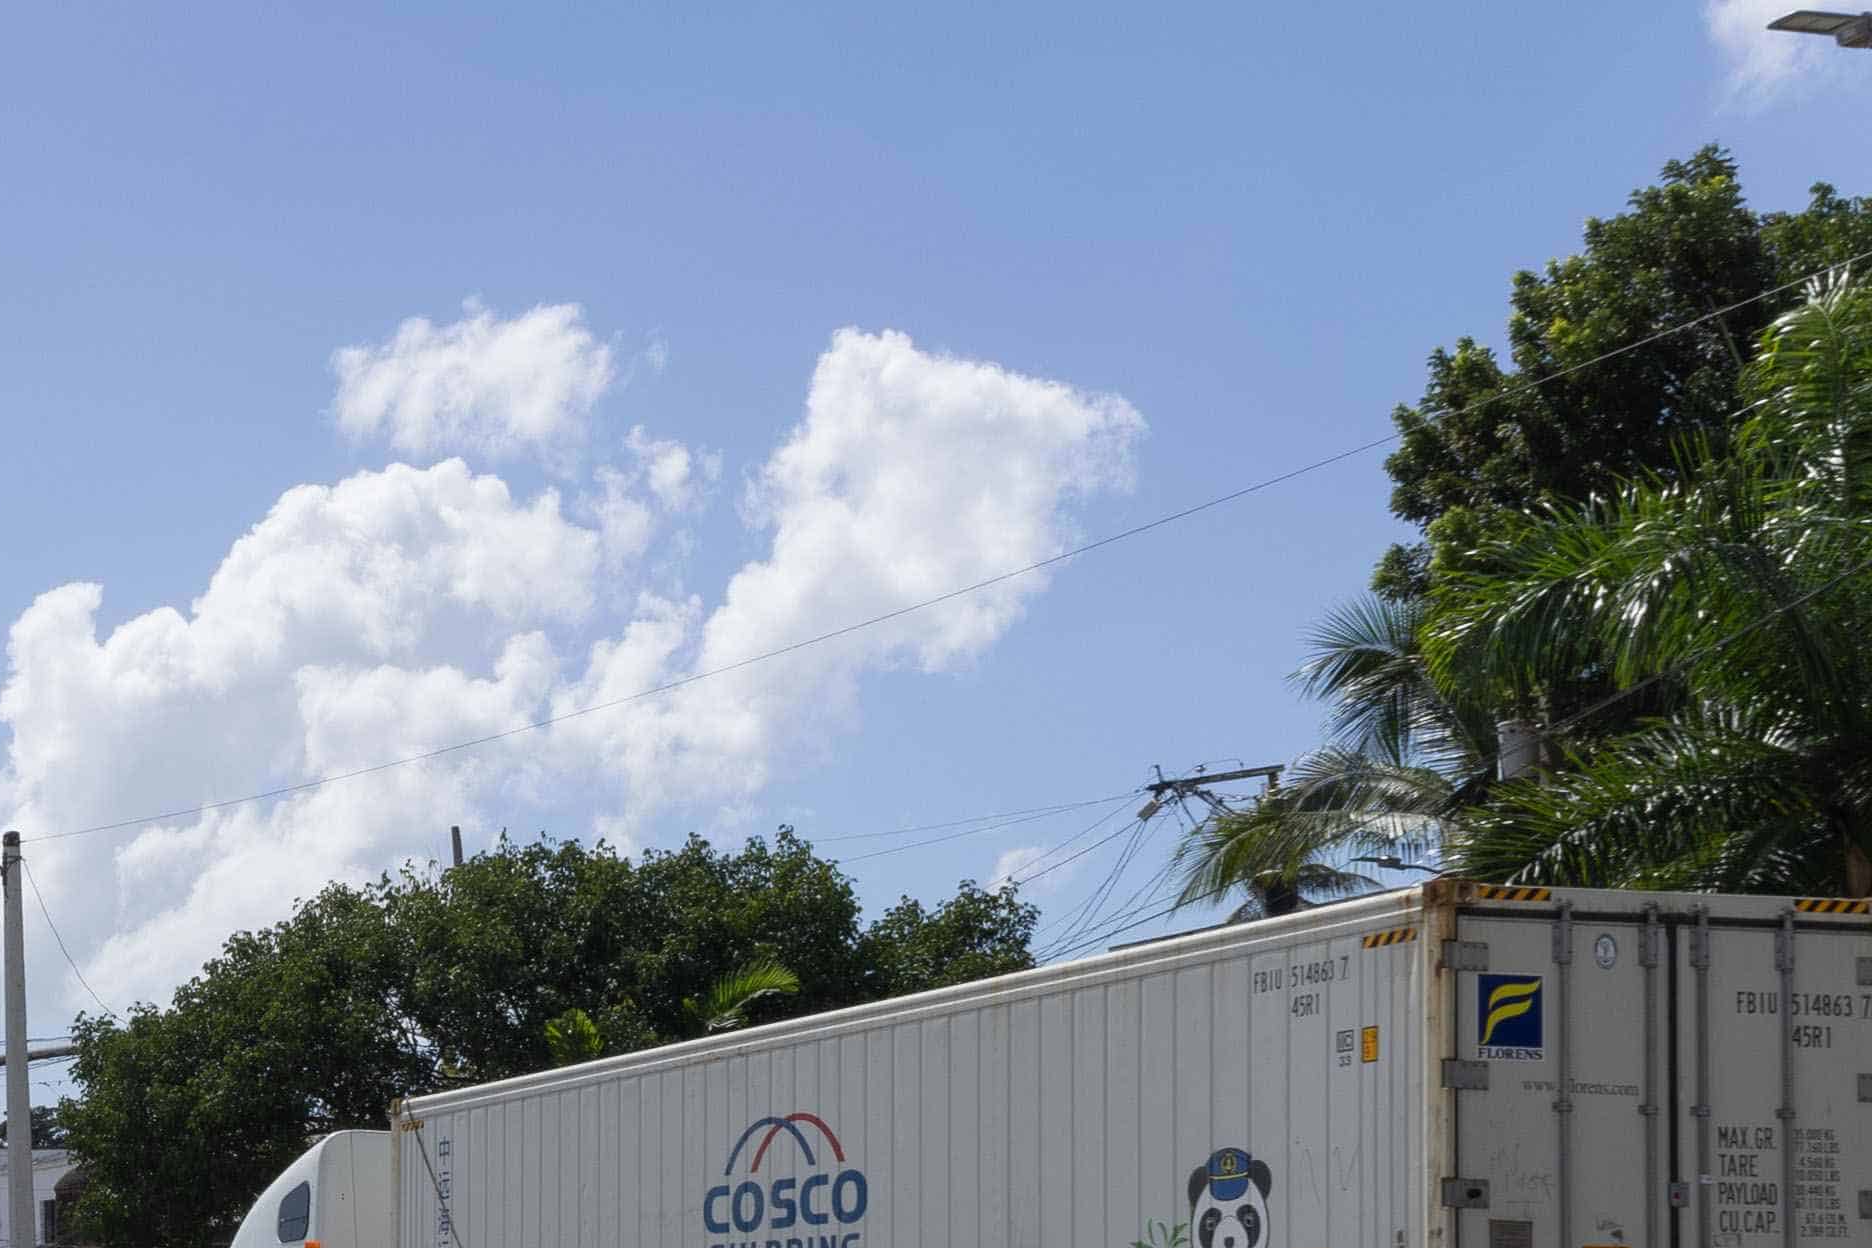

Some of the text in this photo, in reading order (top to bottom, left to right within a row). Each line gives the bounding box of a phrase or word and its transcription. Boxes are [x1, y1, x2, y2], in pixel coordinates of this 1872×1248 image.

[1254, 955, 1350, 993] FBIU 514863 7
[1291, 993, 1321, 1018] 45R1
[1736, 991, 1777, 1015] FBIU
[1791, 993, 1853, 1017] 514863
[1792, 1025, 1832, 1048] 45R1
[1478, 1047, 1544, 1060] FLORENS
[1718, 1154, 1759, 1177] TARE
[703, 1168, 869, 1234] COSCO
[1718, 1182, 1778, 1206] PAYLOAD
